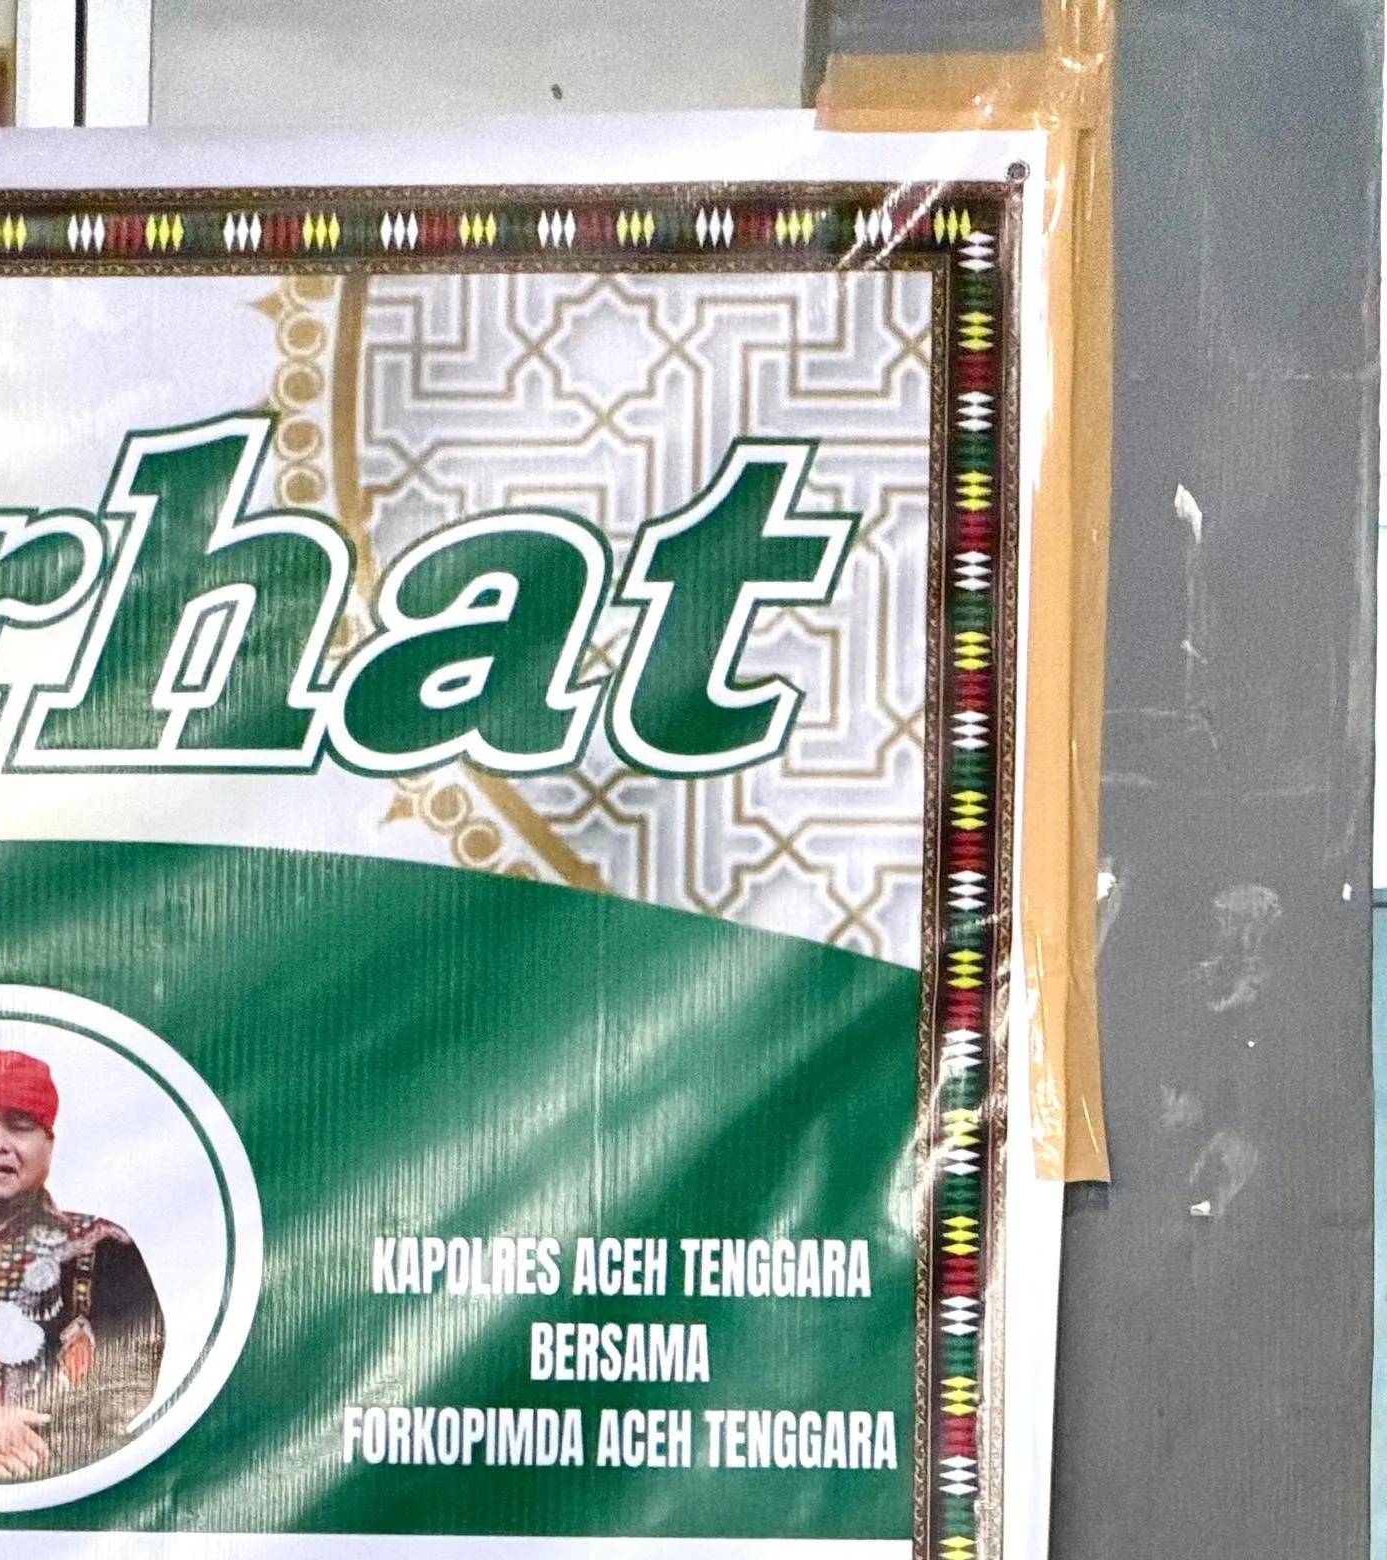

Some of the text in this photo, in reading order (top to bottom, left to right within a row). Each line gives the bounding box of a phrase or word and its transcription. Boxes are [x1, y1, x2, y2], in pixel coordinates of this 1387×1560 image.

[372, 1236, 872, 1299] KAPOLRES ACEH TENGGARA
[529, 1323, 710, 1383] BERSAMA
[342, 1406, 898, 1470] FORKOPIMDA ACEH TENGGARA
